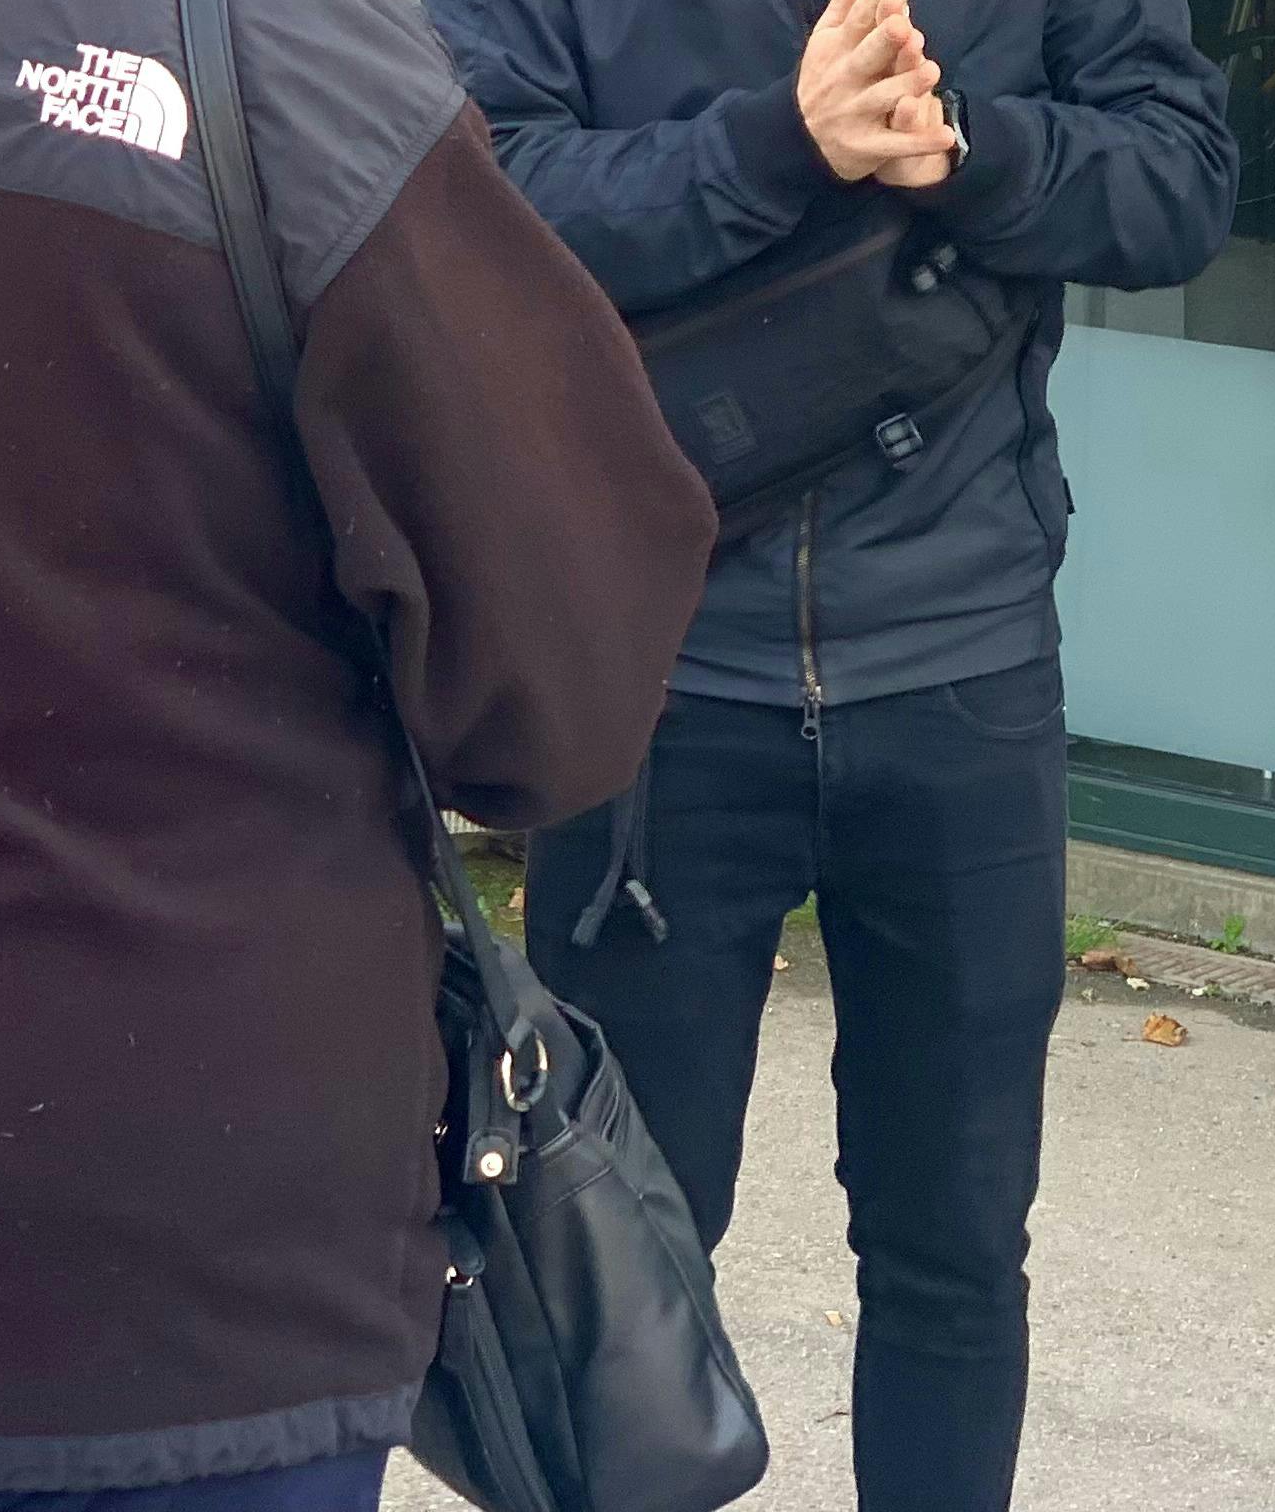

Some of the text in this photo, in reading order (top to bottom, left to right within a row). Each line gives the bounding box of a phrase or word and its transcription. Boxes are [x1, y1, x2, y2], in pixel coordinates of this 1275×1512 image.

[77, 43, 142, 81] THE
[15, 59, 134, 112] NORTH
[40, 93, 128, 139] FACE
